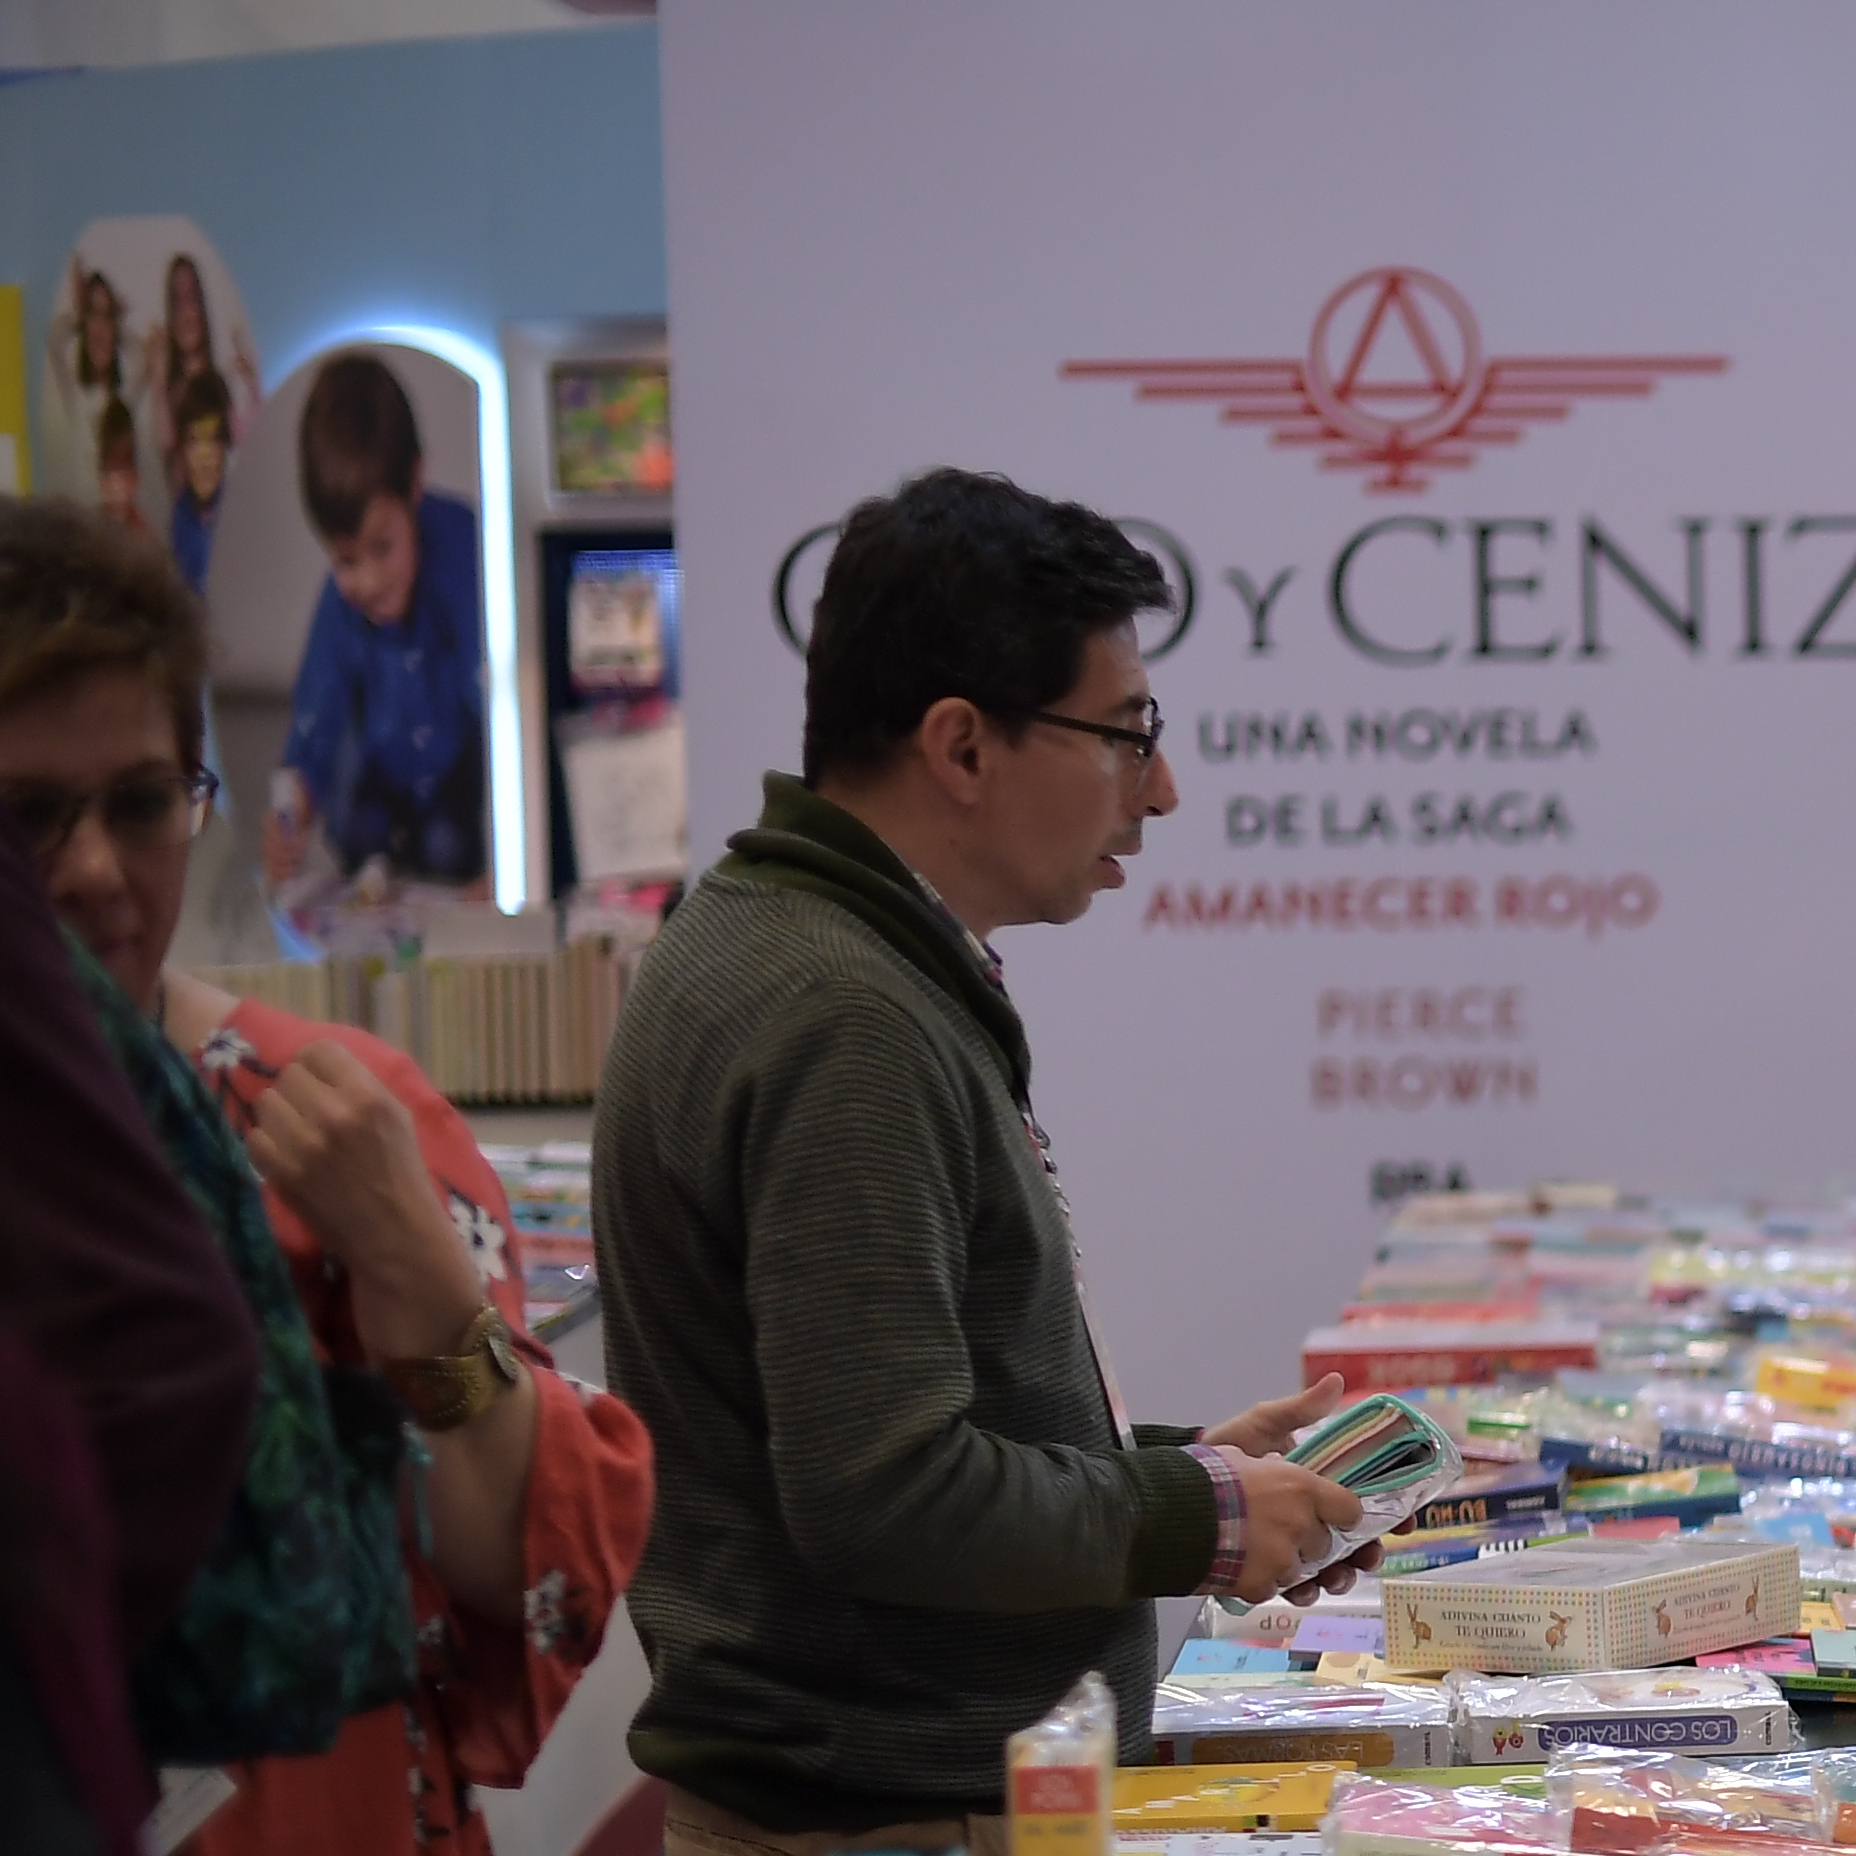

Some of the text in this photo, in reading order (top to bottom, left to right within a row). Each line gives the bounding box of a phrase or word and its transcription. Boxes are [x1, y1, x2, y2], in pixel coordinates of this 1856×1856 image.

[1223, 565, 1298, 659] Y
[1198, 705, 1593, 761] UNA NOVELA
[1226, 792, 1575, 847] DE LA SAGA
[1142, 872, 1662, 940] AMANECER ROJO
[1316, 986, 1526, 1040] PIERCE
[1310, 1053, 1540, 1112] BROWN
[1441, 1611, 1488, 1621] ADIVINA
[1455, 1625, 1526, 1640] TE QUIERO
[1321, 1739, 1365, 1760] LAS
[1543, 1719, 1732, 1747] LOS CONTRARIOS
